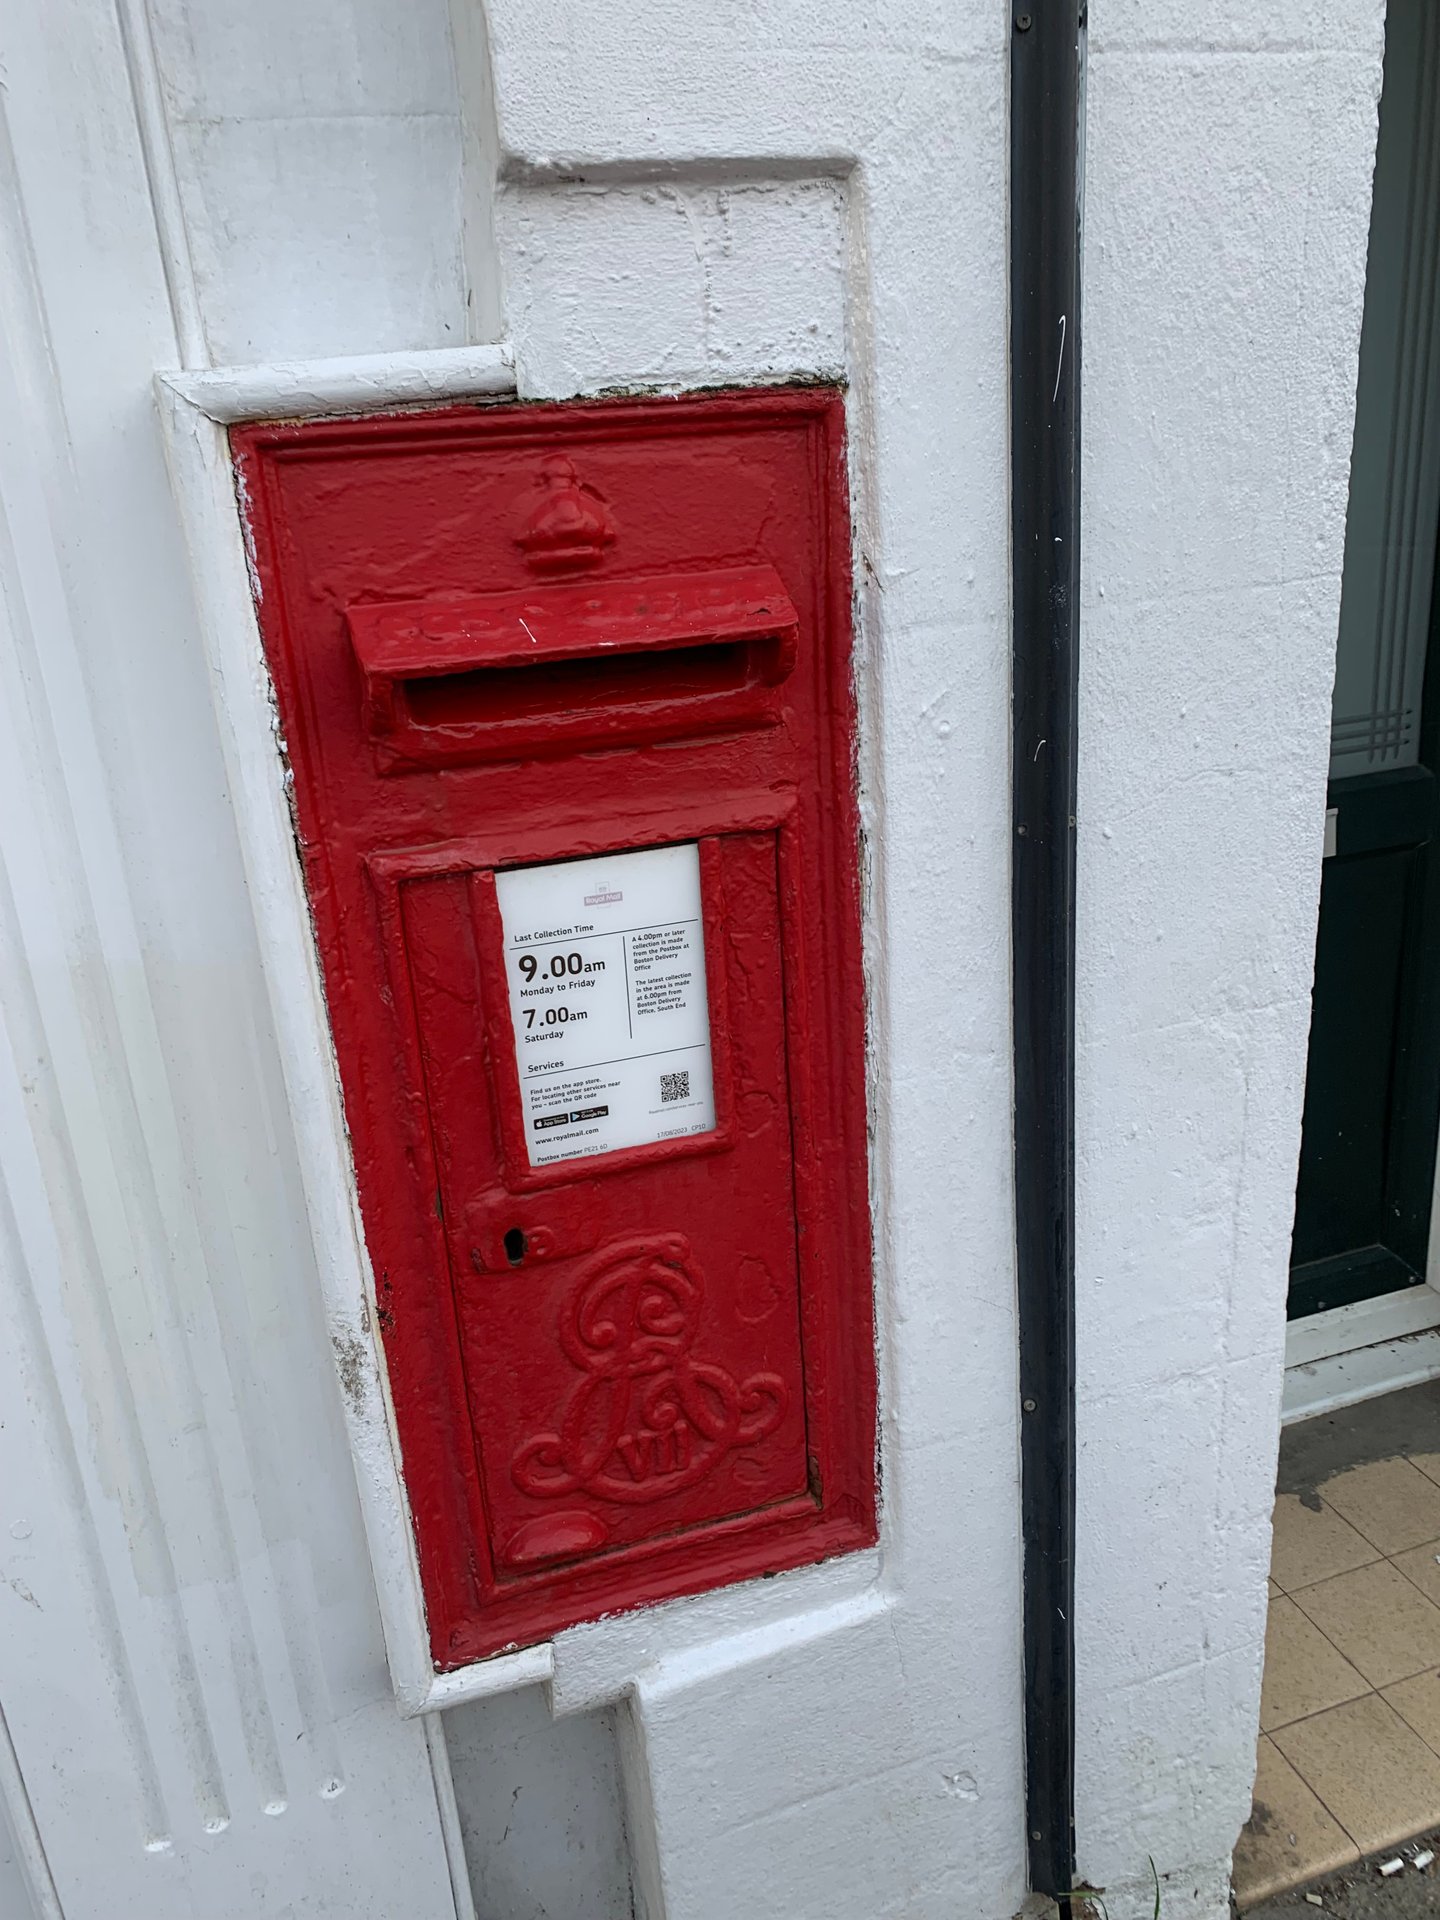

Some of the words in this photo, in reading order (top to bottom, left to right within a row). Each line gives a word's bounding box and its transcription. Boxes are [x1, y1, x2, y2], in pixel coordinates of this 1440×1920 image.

[534, 928, 572, 938] Collection
[638, 933, 662, 941] 4.00pm
[633, 941, 660, 949] collection
[660, 945, 681, 953] Postbox
[634, 956, 653, 964] Boston
[655, 953, 678, 961] Delivery
[519, 953, 605, 982] 9.00am
[665, 972, 691, 981] collection
[521, 985, 554, 997] Monday
[569, 979, 595, 989] Friday
[644, 991, 667, 999] 6.00pm
[658, 996, 681, 1005] Delivery
[523, 1007, 587, 1028] 7.00am
[525, 1031, 564, 1043] Saturday
[528, 1060, 564, 1072] Services
[542, 1091, 565, 1101] locating
[584, 1084, 606, 1092] services
[535, 1128, 599, 1145] www.royalmail.com
[537, 1154, 559, 1162] Postbox
[561, 1149, 583, 1158] number
